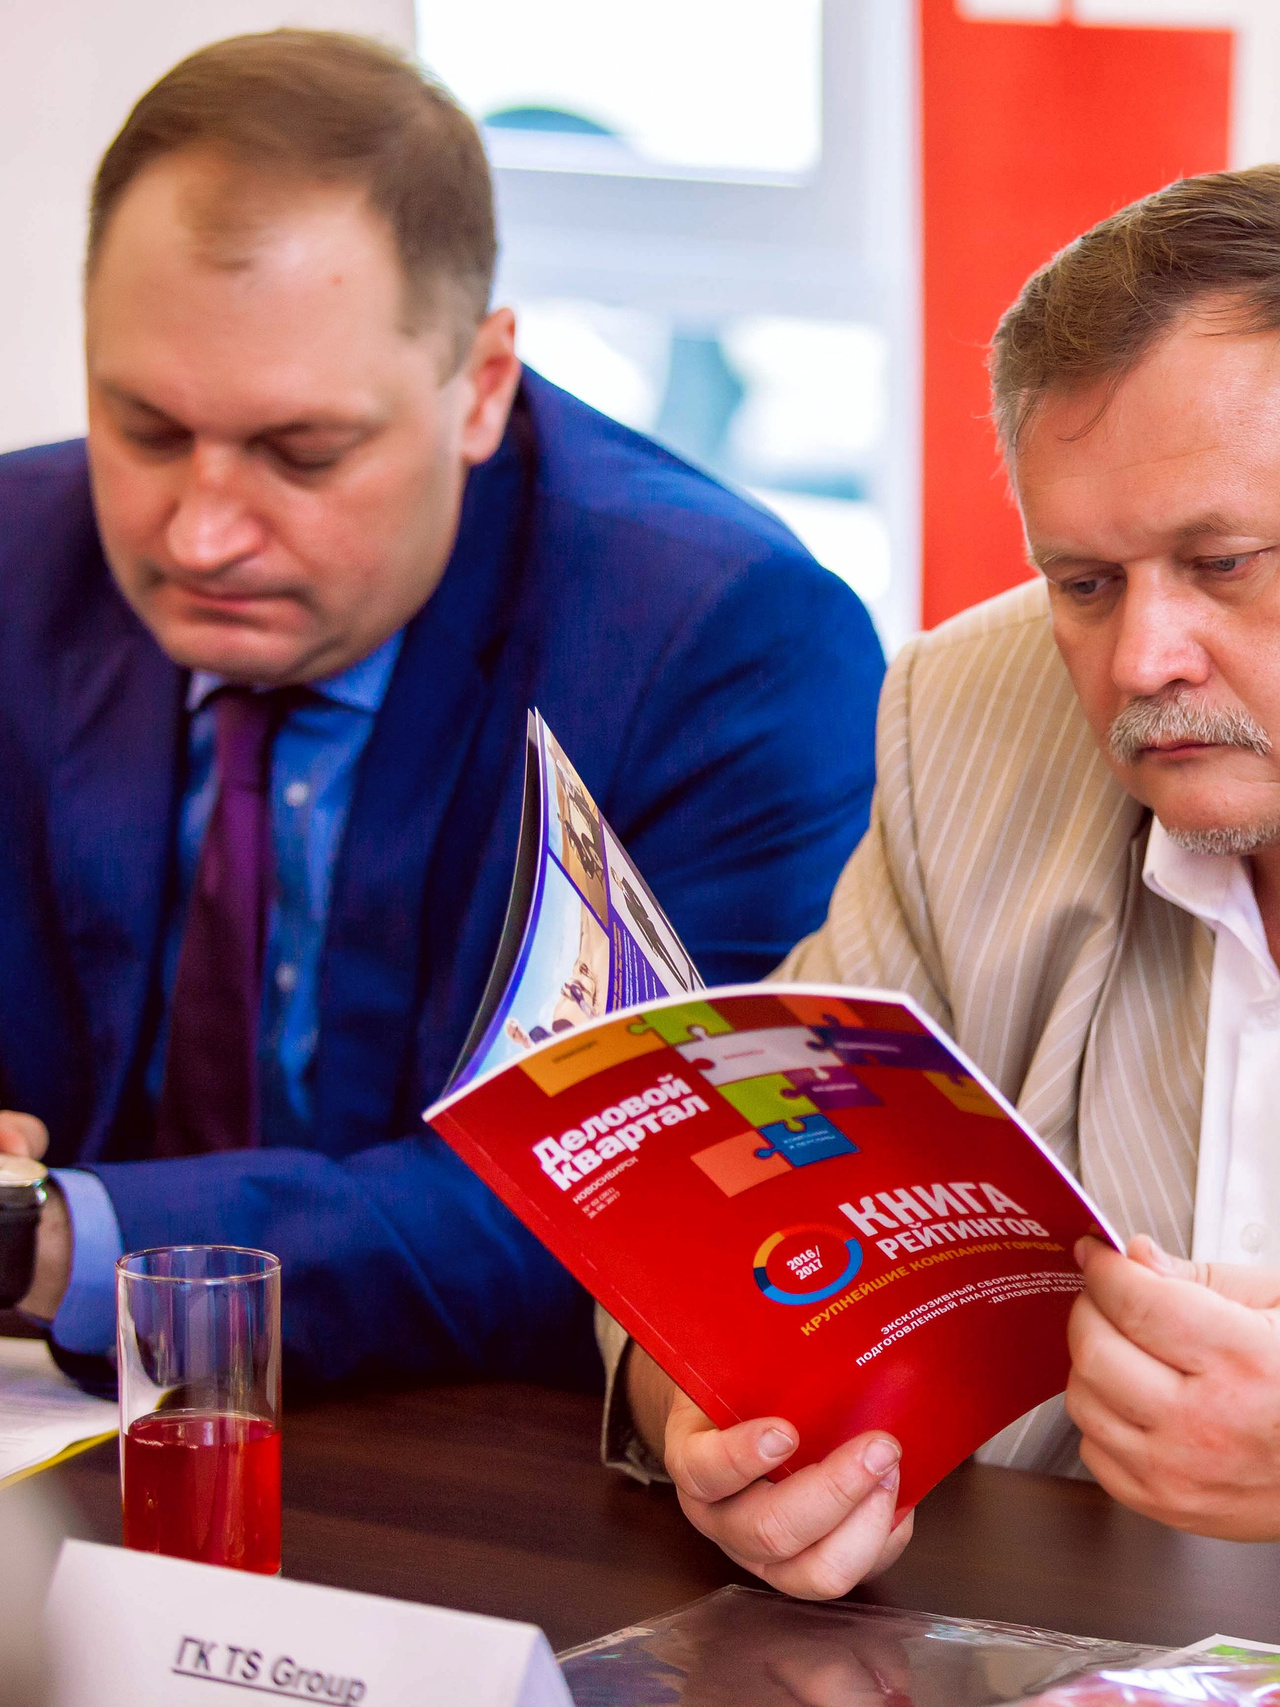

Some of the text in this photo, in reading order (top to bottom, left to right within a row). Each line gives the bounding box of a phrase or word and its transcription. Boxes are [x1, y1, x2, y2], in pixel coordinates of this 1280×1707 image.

[531, 1072, 693, 1176] Деловой
[572, 1155, 639, 1204] НОВОСИБИРСК
[838, 1182, 1029, 1237] КНИГА
[786, 1245, 820, 1271] 2016/
[875, 1217, 1050, 1261] РЕЙТИНГОВ
[795, 1257, 824, 1281] 2017
[800, 1266, 911, 1337] КРУПНЕЙШИЕ
[911, 1242, 1003, 1272] КОМПАНИИ
[1051, 1285, 1085, 1293] КВАРТ
[856, 1278, 1085, 1367] ПОДГОТОВЛЕННЫЙ АНАЛИТИЧЕСКОЙ ГРУПП
[880, 1272, 1084, 1335] ЭКСКЛЮЗИВНЫЙ СБОРНИК РЕЙТИНГО
[177, 1635, 367, 1706] ГК TS Group
